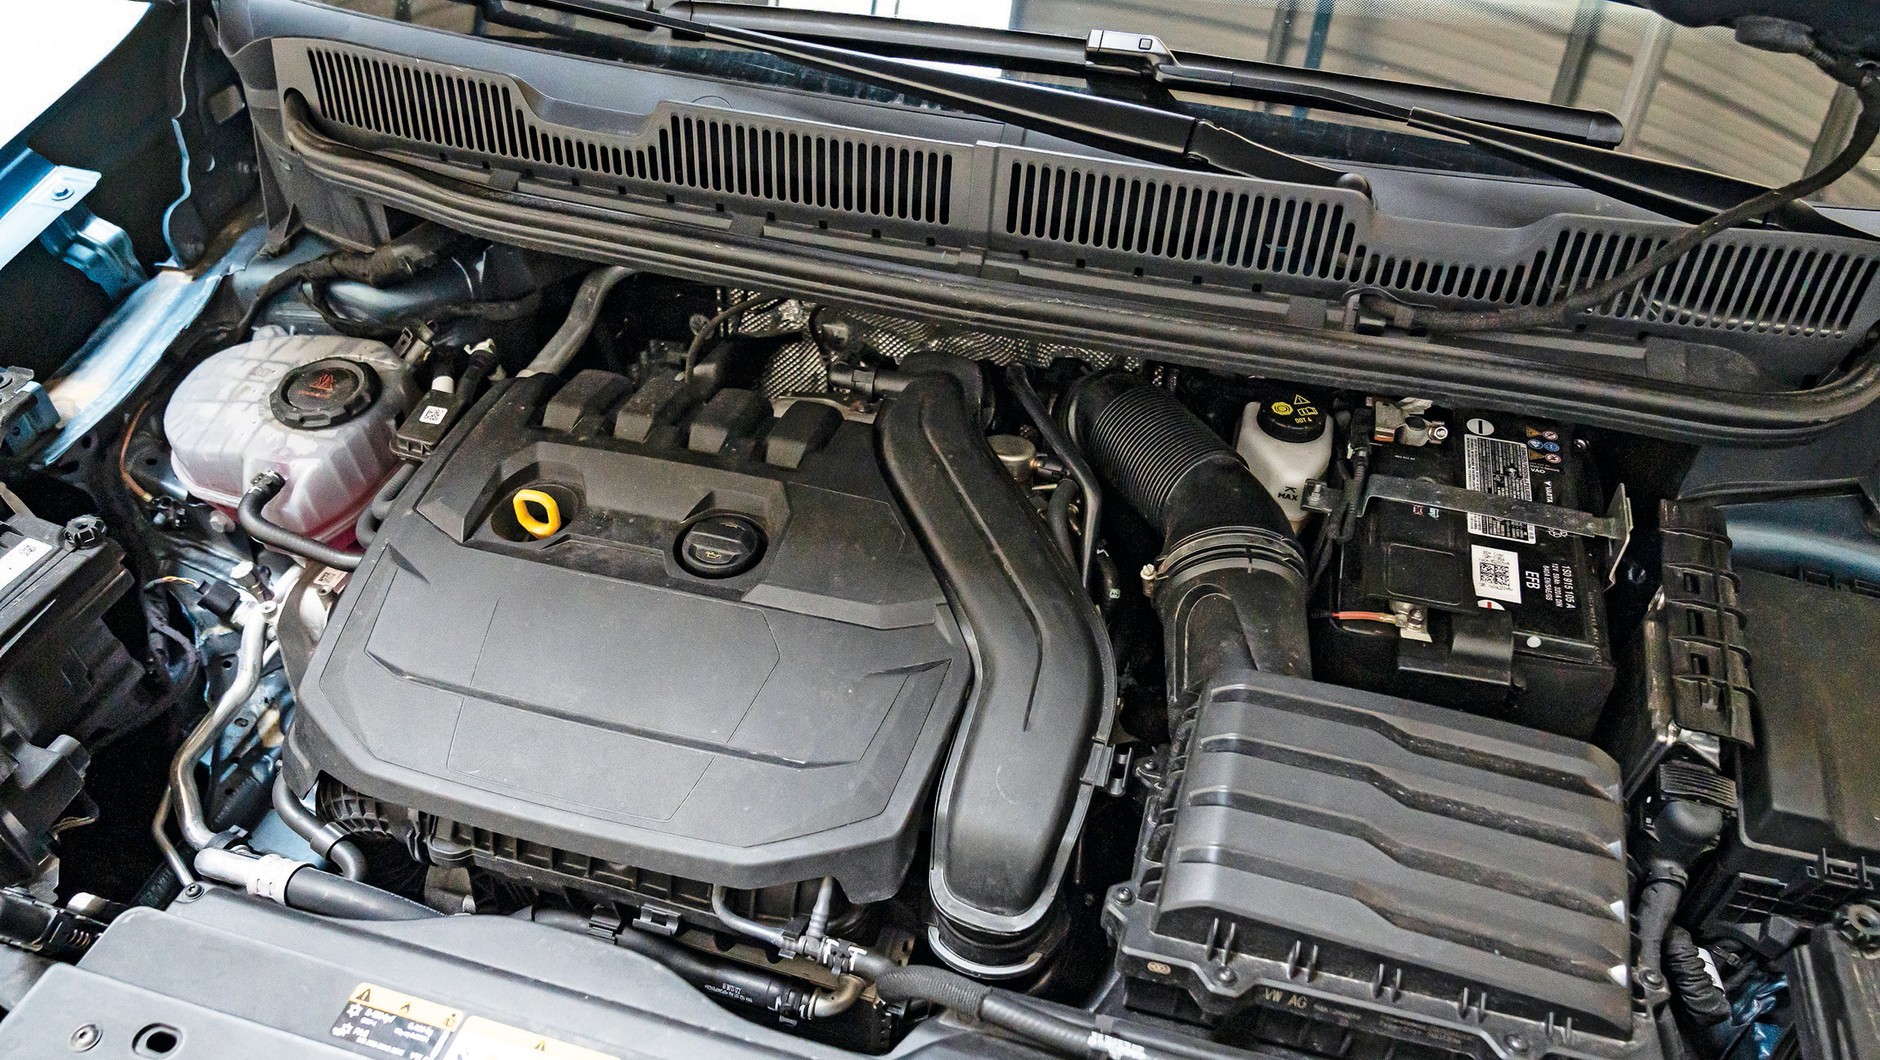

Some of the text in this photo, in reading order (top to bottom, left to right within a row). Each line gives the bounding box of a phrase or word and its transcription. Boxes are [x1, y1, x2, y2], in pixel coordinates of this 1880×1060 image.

[1278, 492, 1298, 501] MAX
[1546, 486, 1554, 502] VARTA
[1552, 562, 1560, 572] 12V
[1525, 570, 1540, 589] EFB
[1563, 578, 1574, 590] 915
[1565, 591, 1575, 602] 105
[1265, 988, 1308, 1009] VW AG
